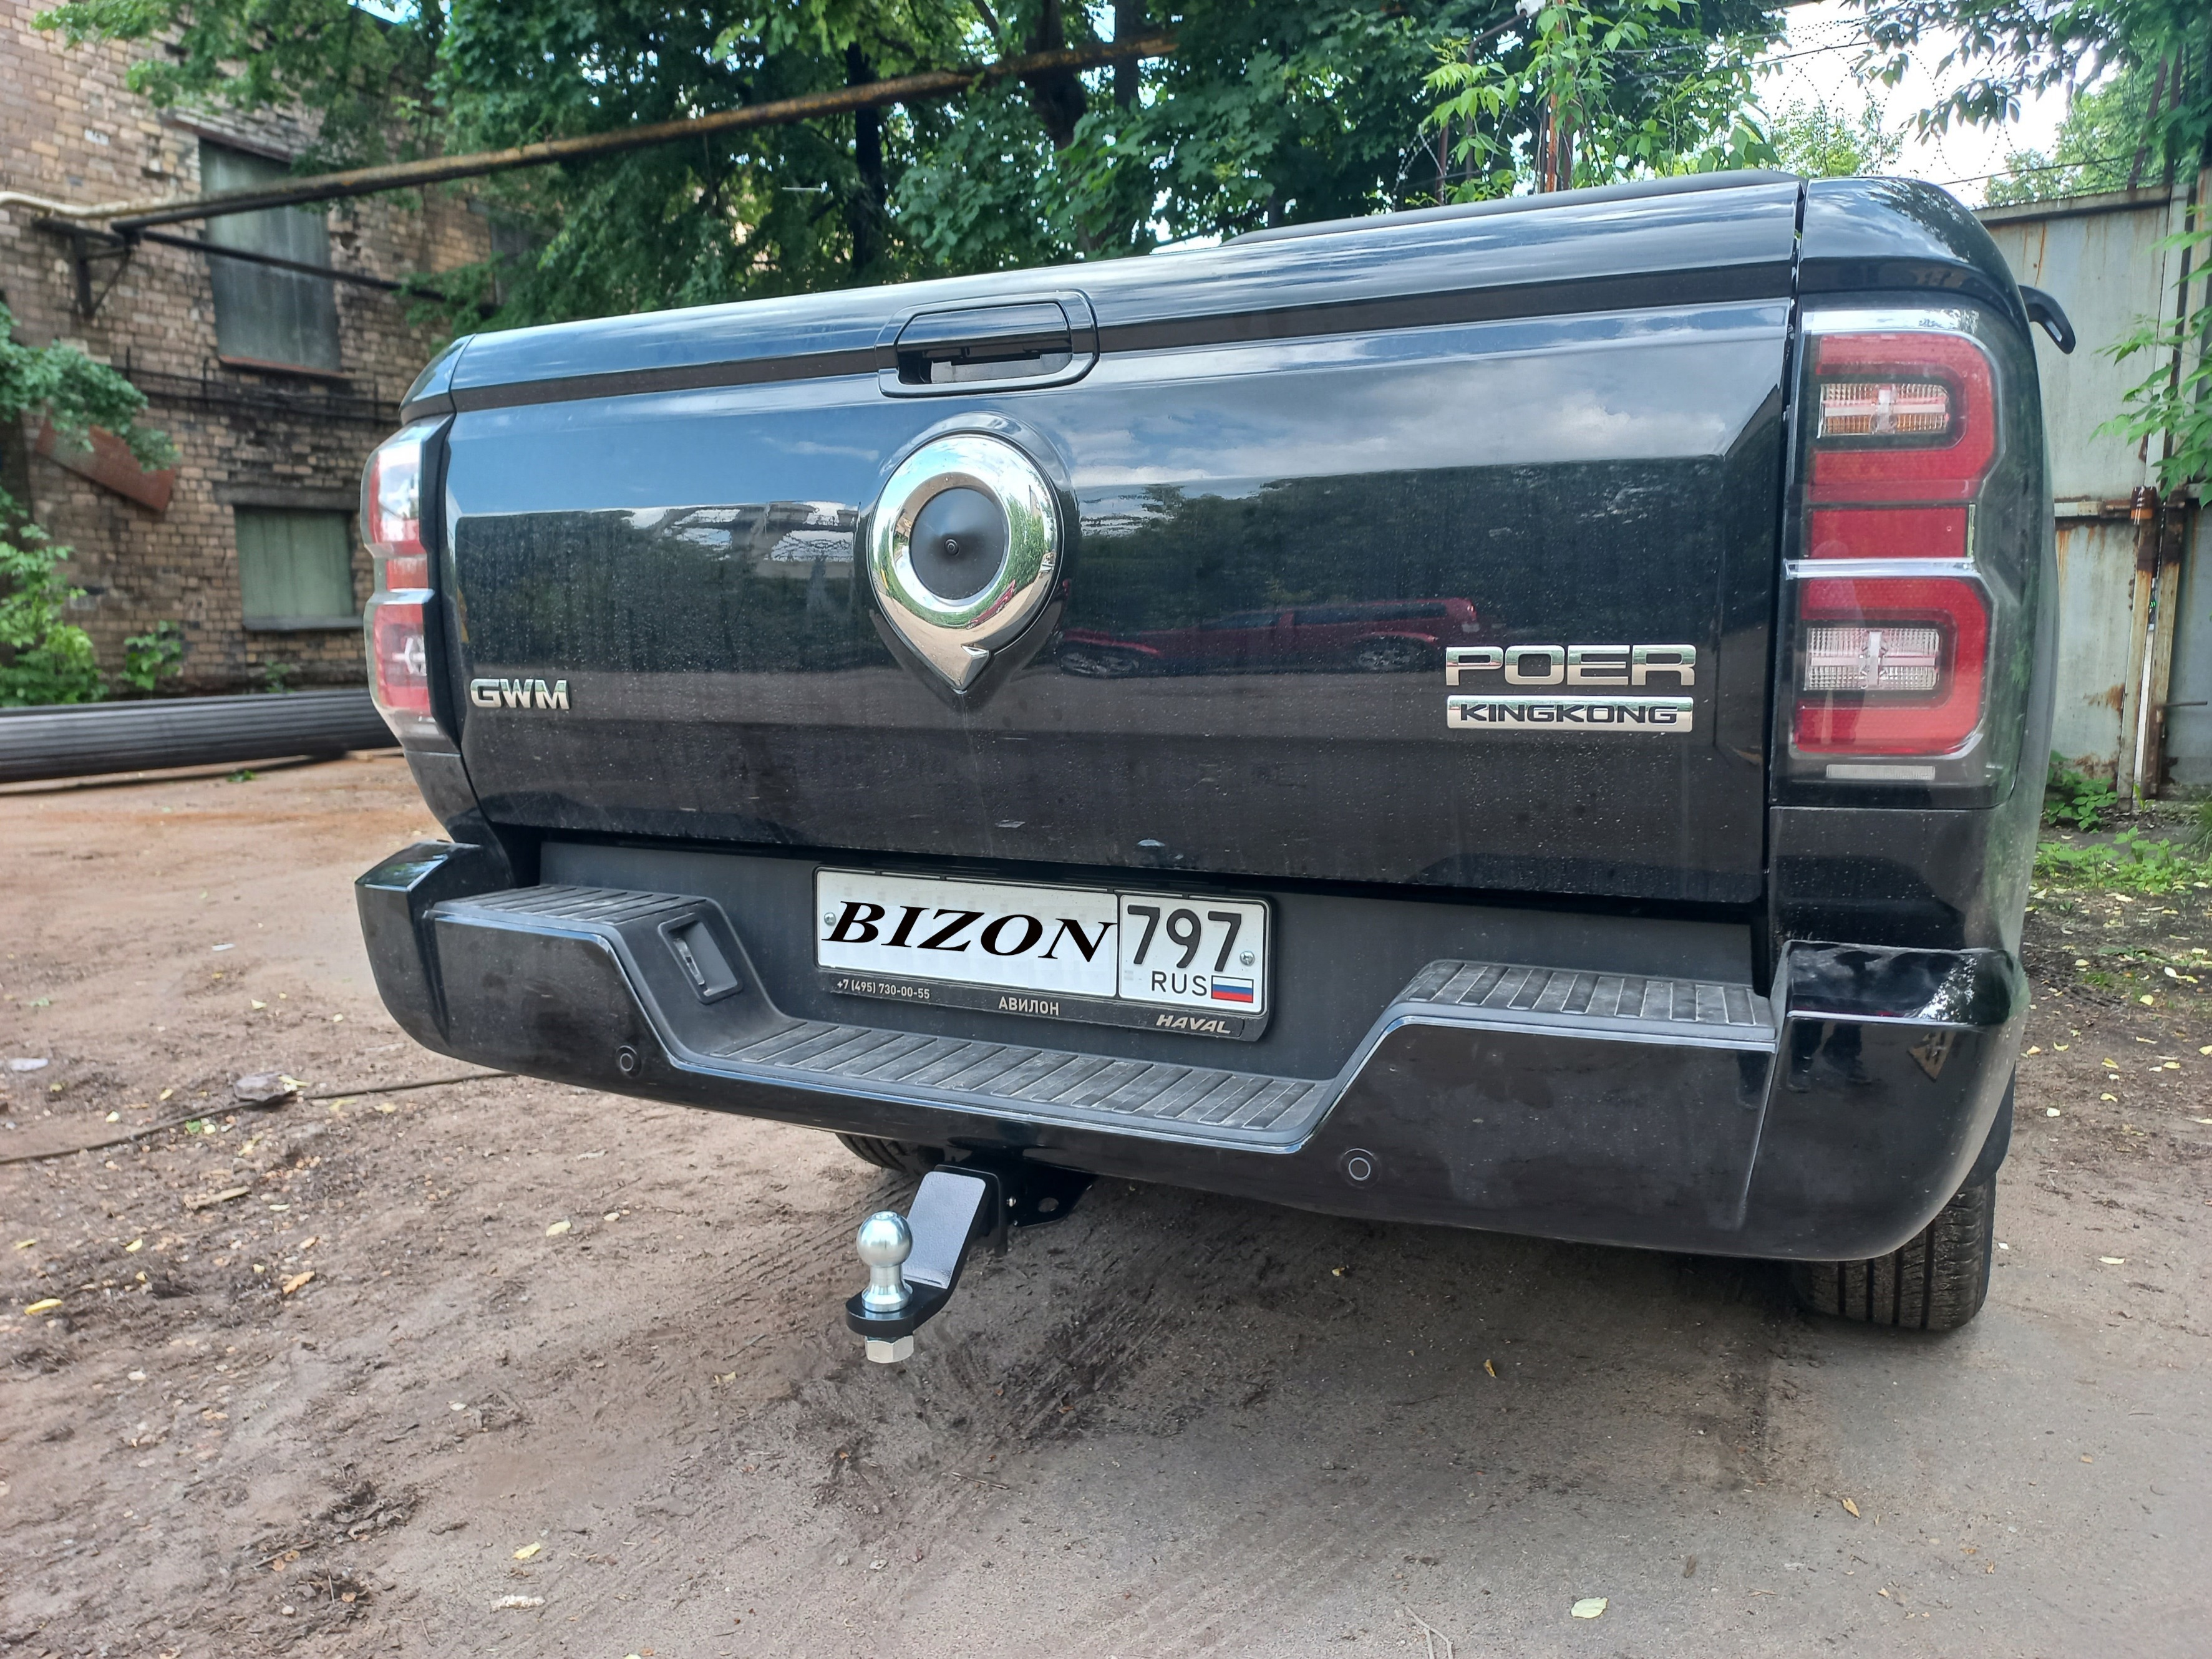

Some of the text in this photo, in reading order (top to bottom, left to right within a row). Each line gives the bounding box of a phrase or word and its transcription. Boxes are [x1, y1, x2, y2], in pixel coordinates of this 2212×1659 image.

[1446, 645, 1696, 685] POER
[470, 679, 570, 709] GWM
[1460, 704, 1678, 723] KINGKONG
[1127, 905, 1242, 972] 797
[837, 980, 930, 999] +7 (495) 730-00-55
[1152, 970, 1208, 997] RUS
[998, 996, 1059, 1015] АВИЛОН
[1156, 1015, 1231, 1034] HAVAL
